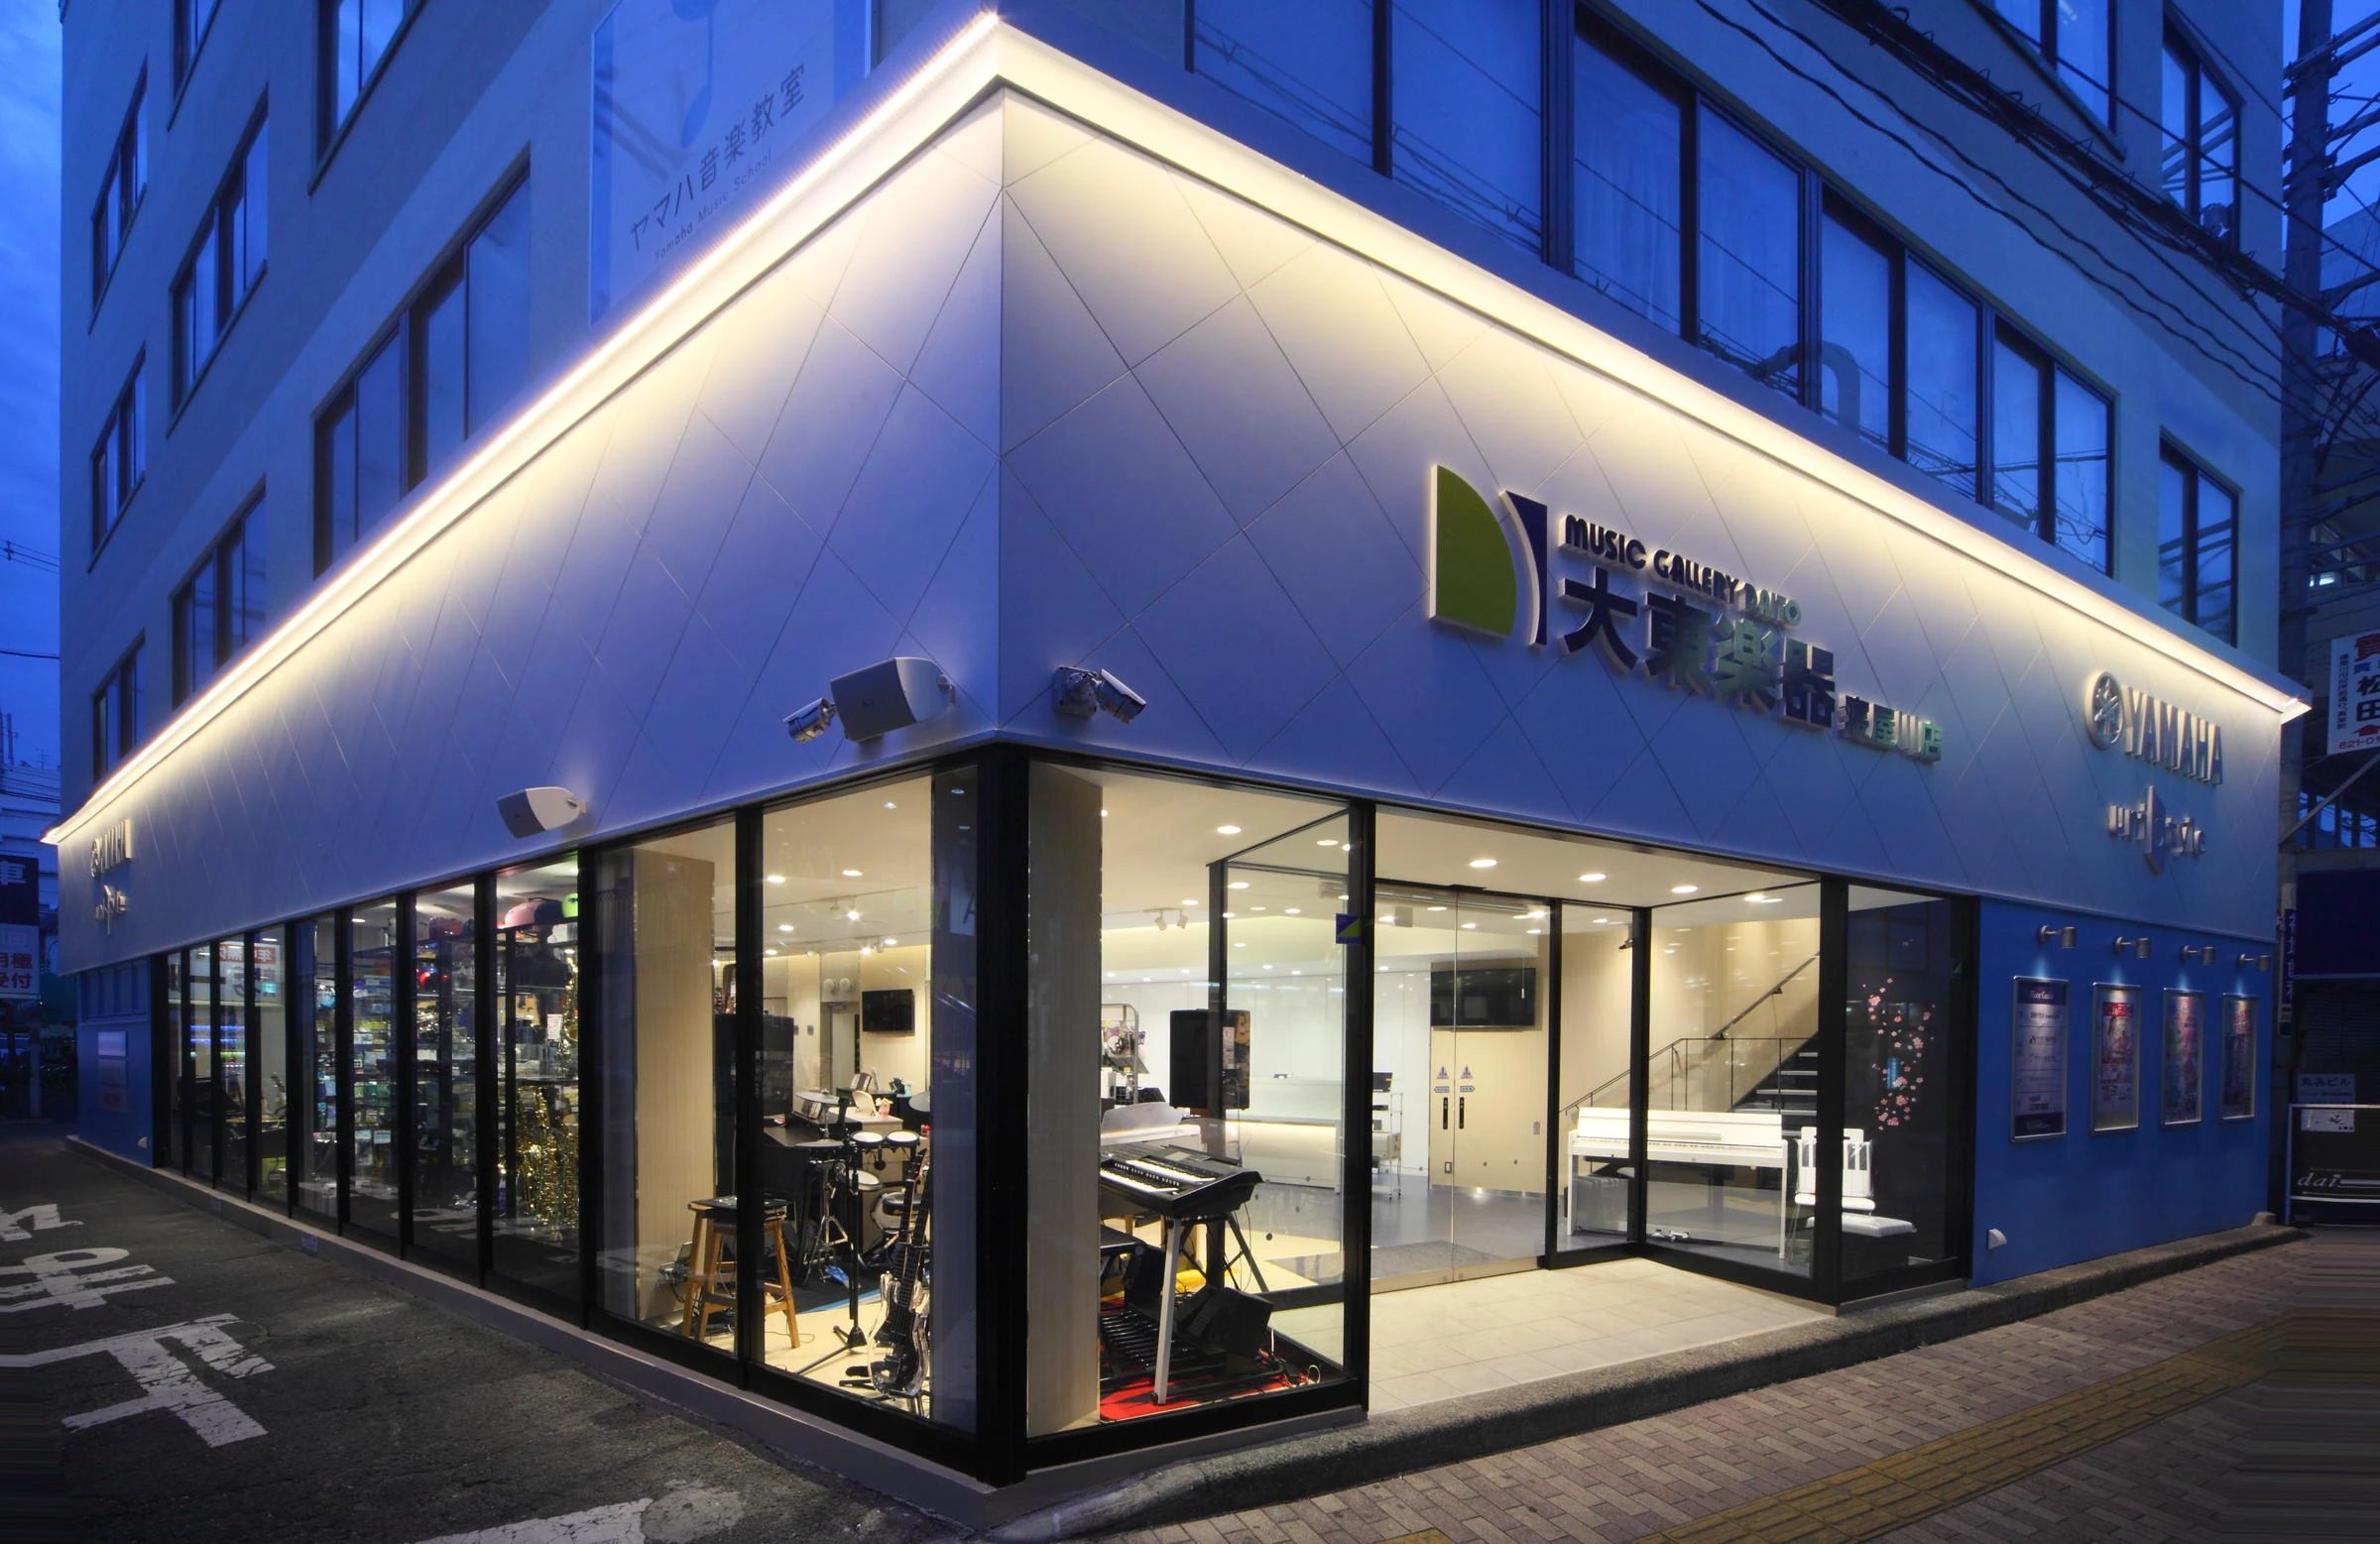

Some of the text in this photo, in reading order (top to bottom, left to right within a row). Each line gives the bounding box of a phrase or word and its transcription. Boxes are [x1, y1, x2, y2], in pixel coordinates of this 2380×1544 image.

[631, 62, 805, 251] ヤマハ音楽教室
[654, 148, 773, 260] Yamaha Music School
[1563, 514, 1802, 627] MUSIC GALLERY DAITO
[1562, 566, 1836, 729] 大東楽器
[2122, 684, 2223, 787] YAMAHA
